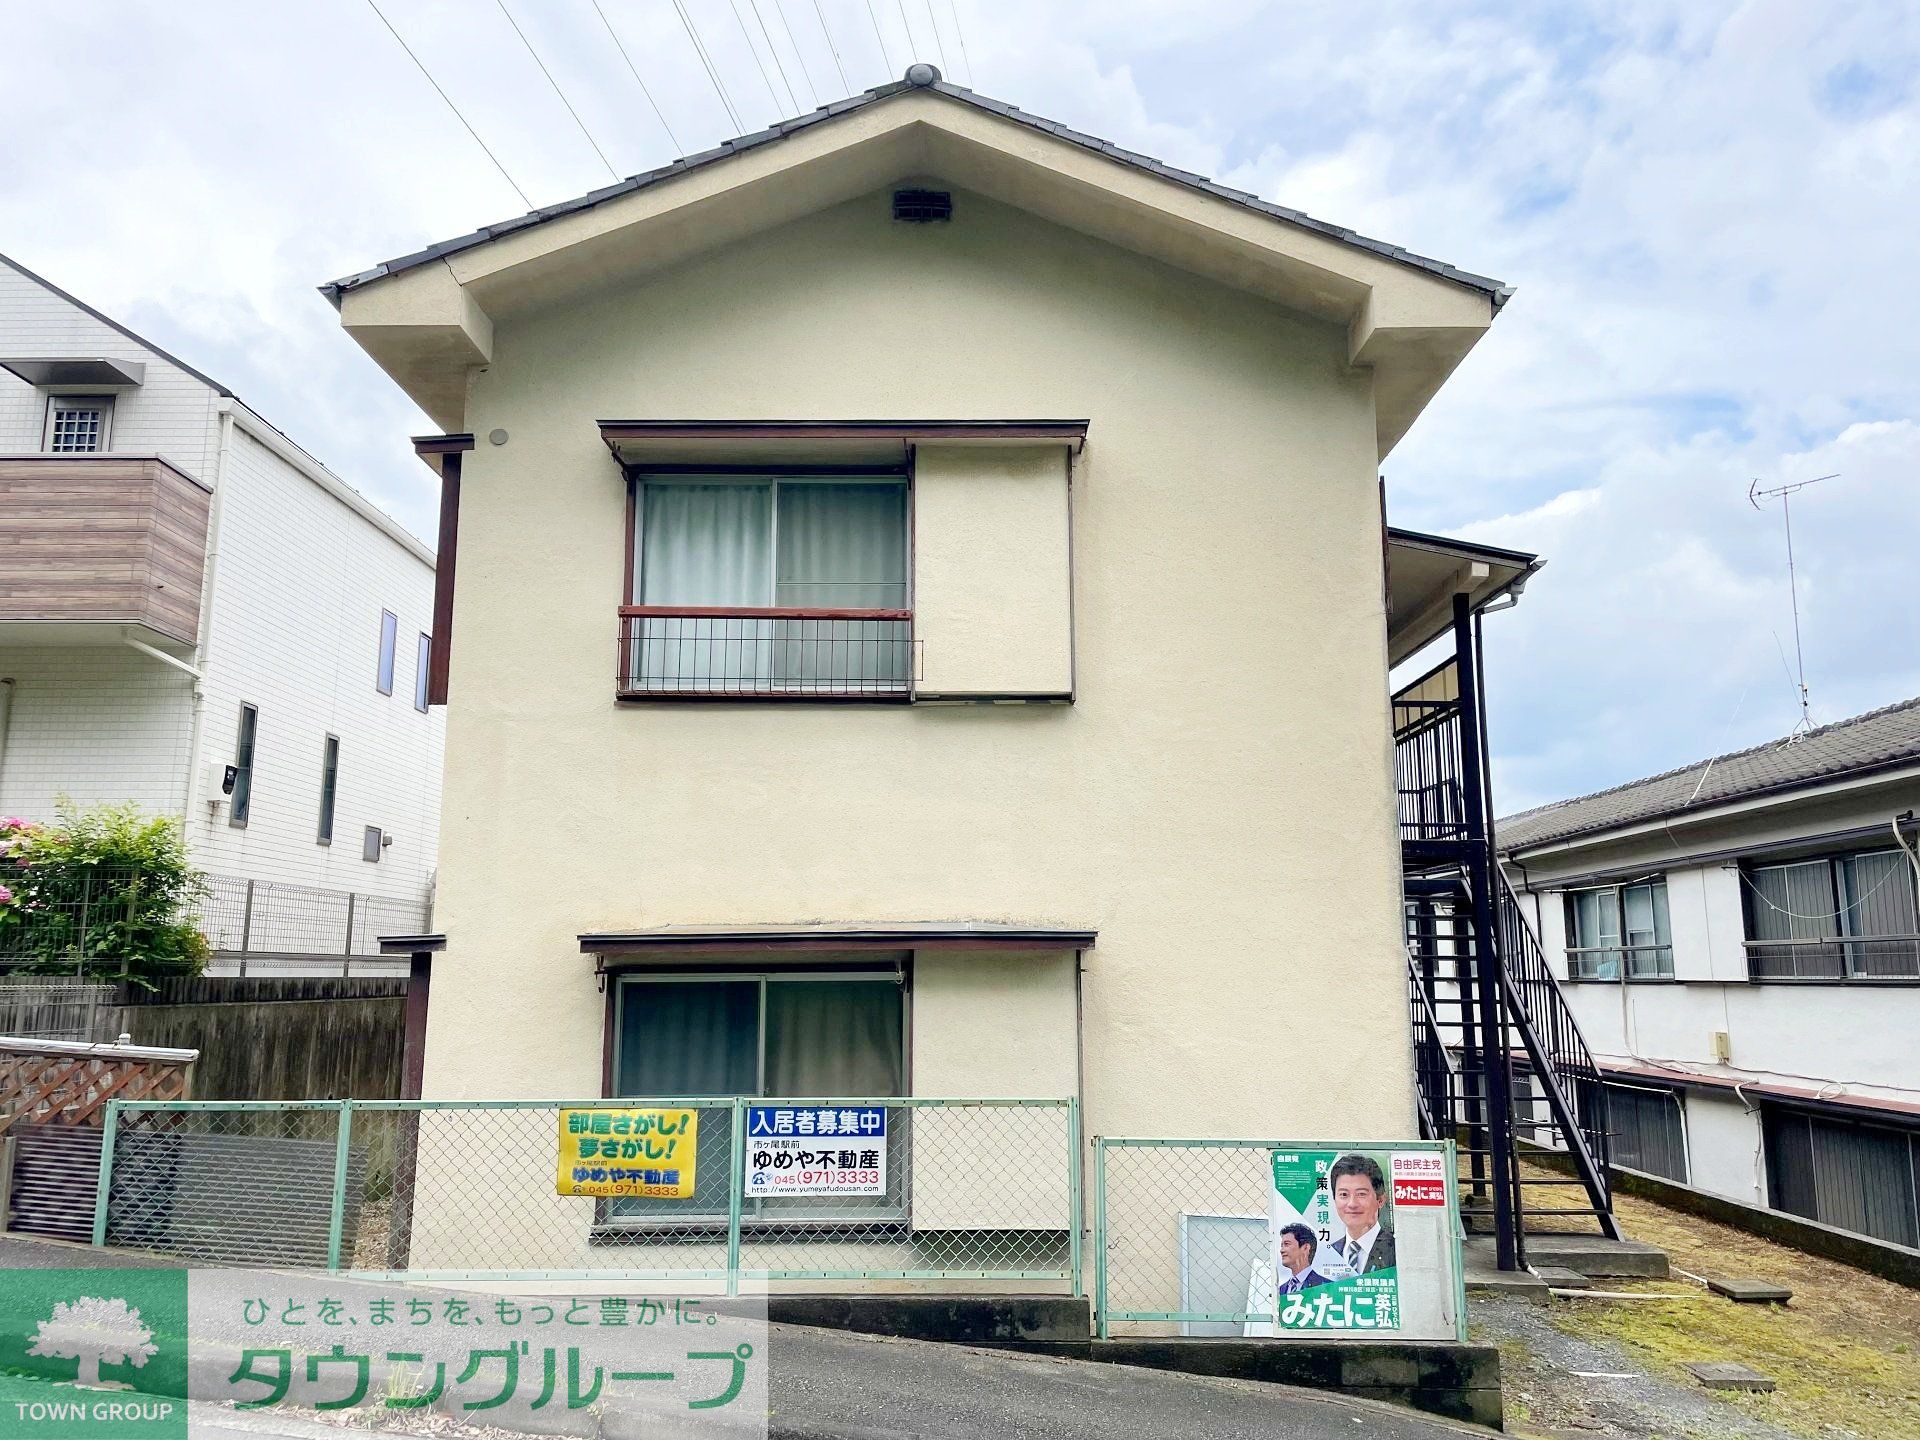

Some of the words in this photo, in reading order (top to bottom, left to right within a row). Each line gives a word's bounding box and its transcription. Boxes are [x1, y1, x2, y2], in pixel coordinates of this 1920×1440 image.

[568, 1112, 690, 1135] 部屋さがし!
[751, 1110, 881, 1135] 入居者募集中
[578, 1138, 677, 1159] 夢さがし!
[753, 1150, 879, 1170] ゆめや不動産
[1394, 1158, 1441, 1170] 自由民主党
[572, 1168, 680, 1185] ゆめや不動産
[774, 1170, 879, 1185] 045(971)3333
[588, 1184, 679, 1196] 045(971)3333
